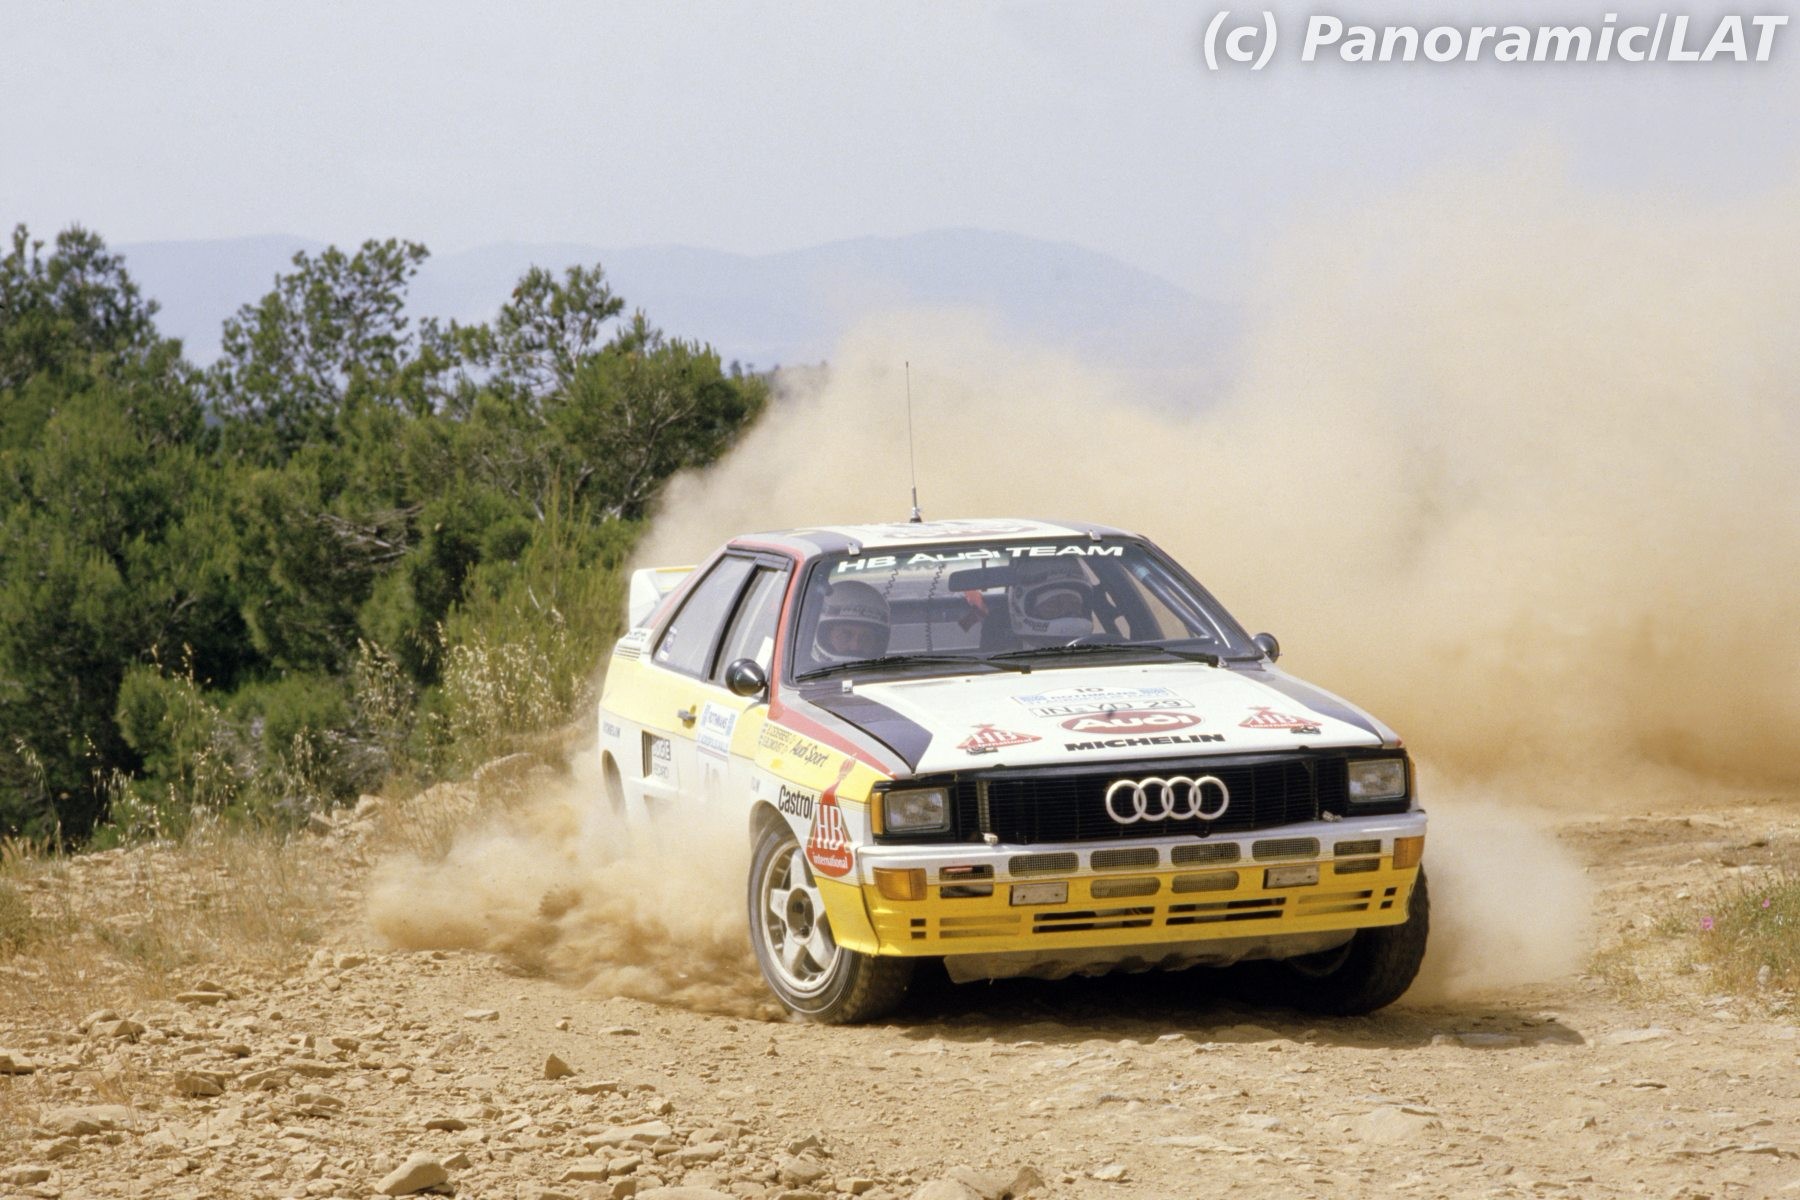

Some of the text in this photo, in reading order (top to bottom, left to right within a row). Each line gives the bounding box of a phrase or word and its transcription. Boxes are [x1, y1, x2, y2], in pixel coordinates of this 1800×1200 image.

[837, 556, 897, 573] HB
[1005, 545, 1124, 558] TEAM
[1063, 733, 1226, 752] MICHELIN
[778, 784, 815, 821] Castrol
[813, 803, 845, 851] HB
